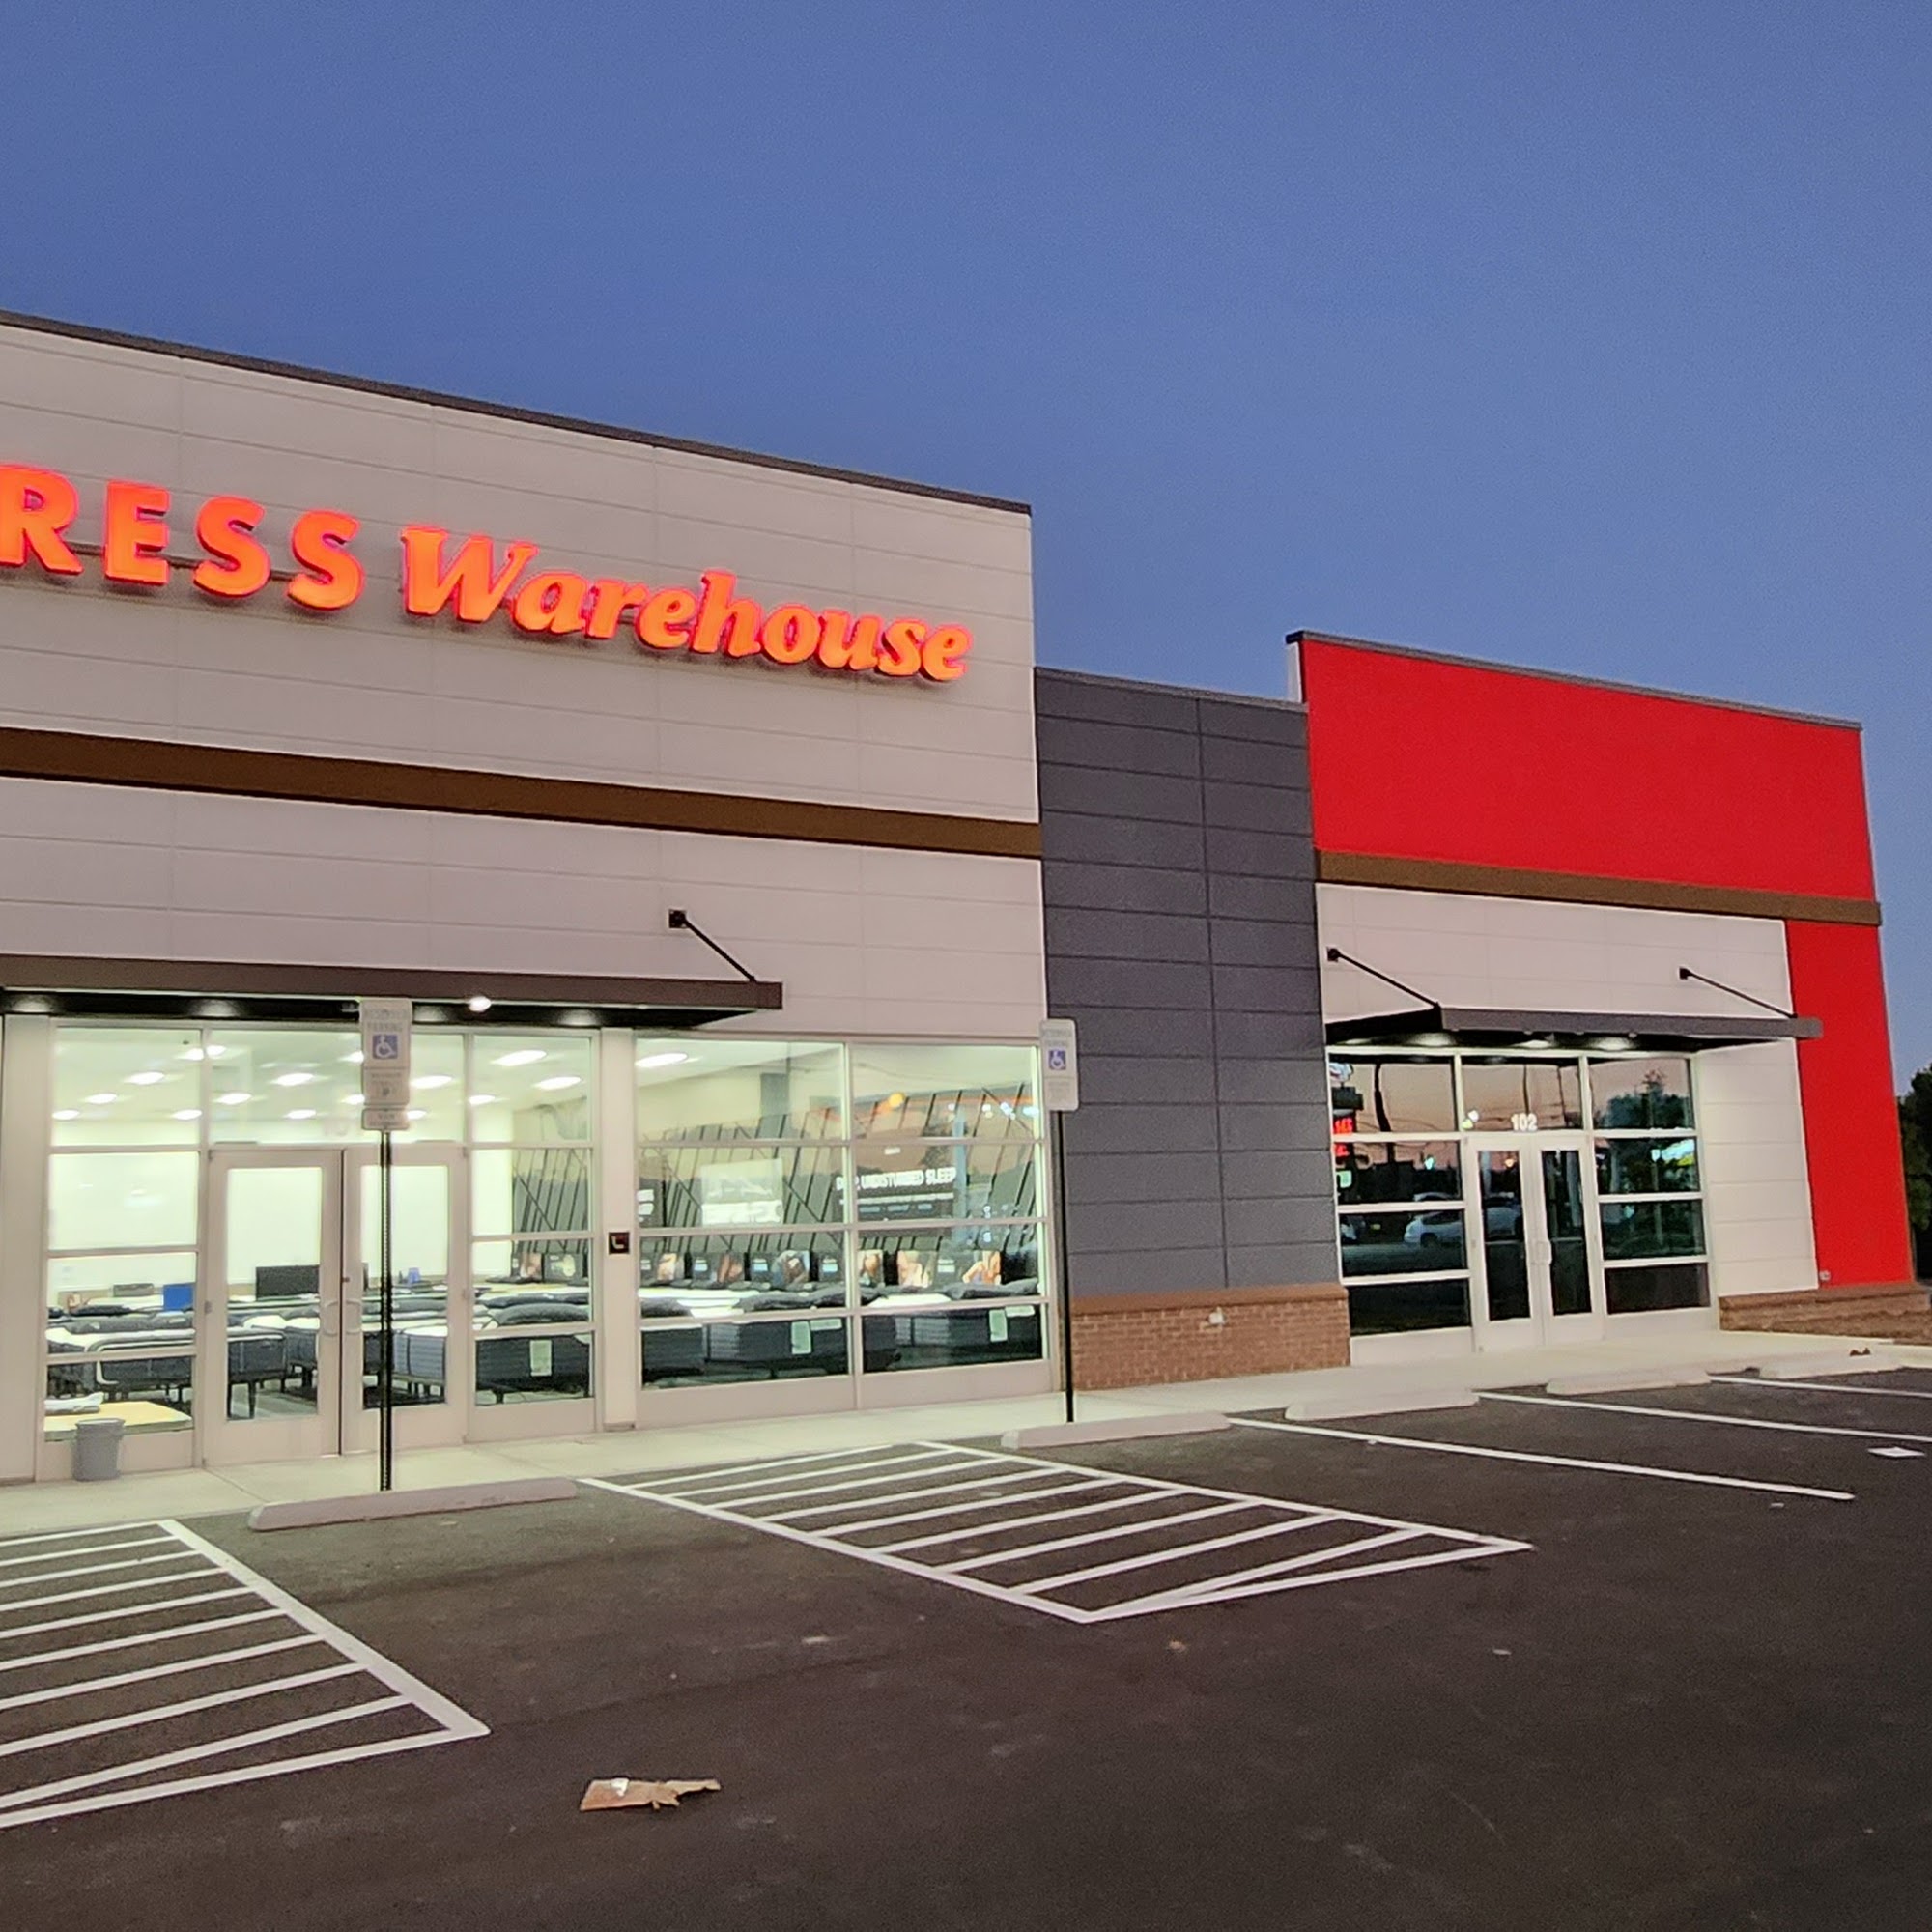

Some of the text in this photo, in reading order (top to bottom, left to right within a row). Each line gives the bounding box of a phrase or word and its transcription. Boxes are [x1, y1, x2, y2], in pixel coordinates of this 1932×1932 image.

[0, 464, 973, 681] RESS Warehouse
[1511, 1113, 1538, 1131] 102
